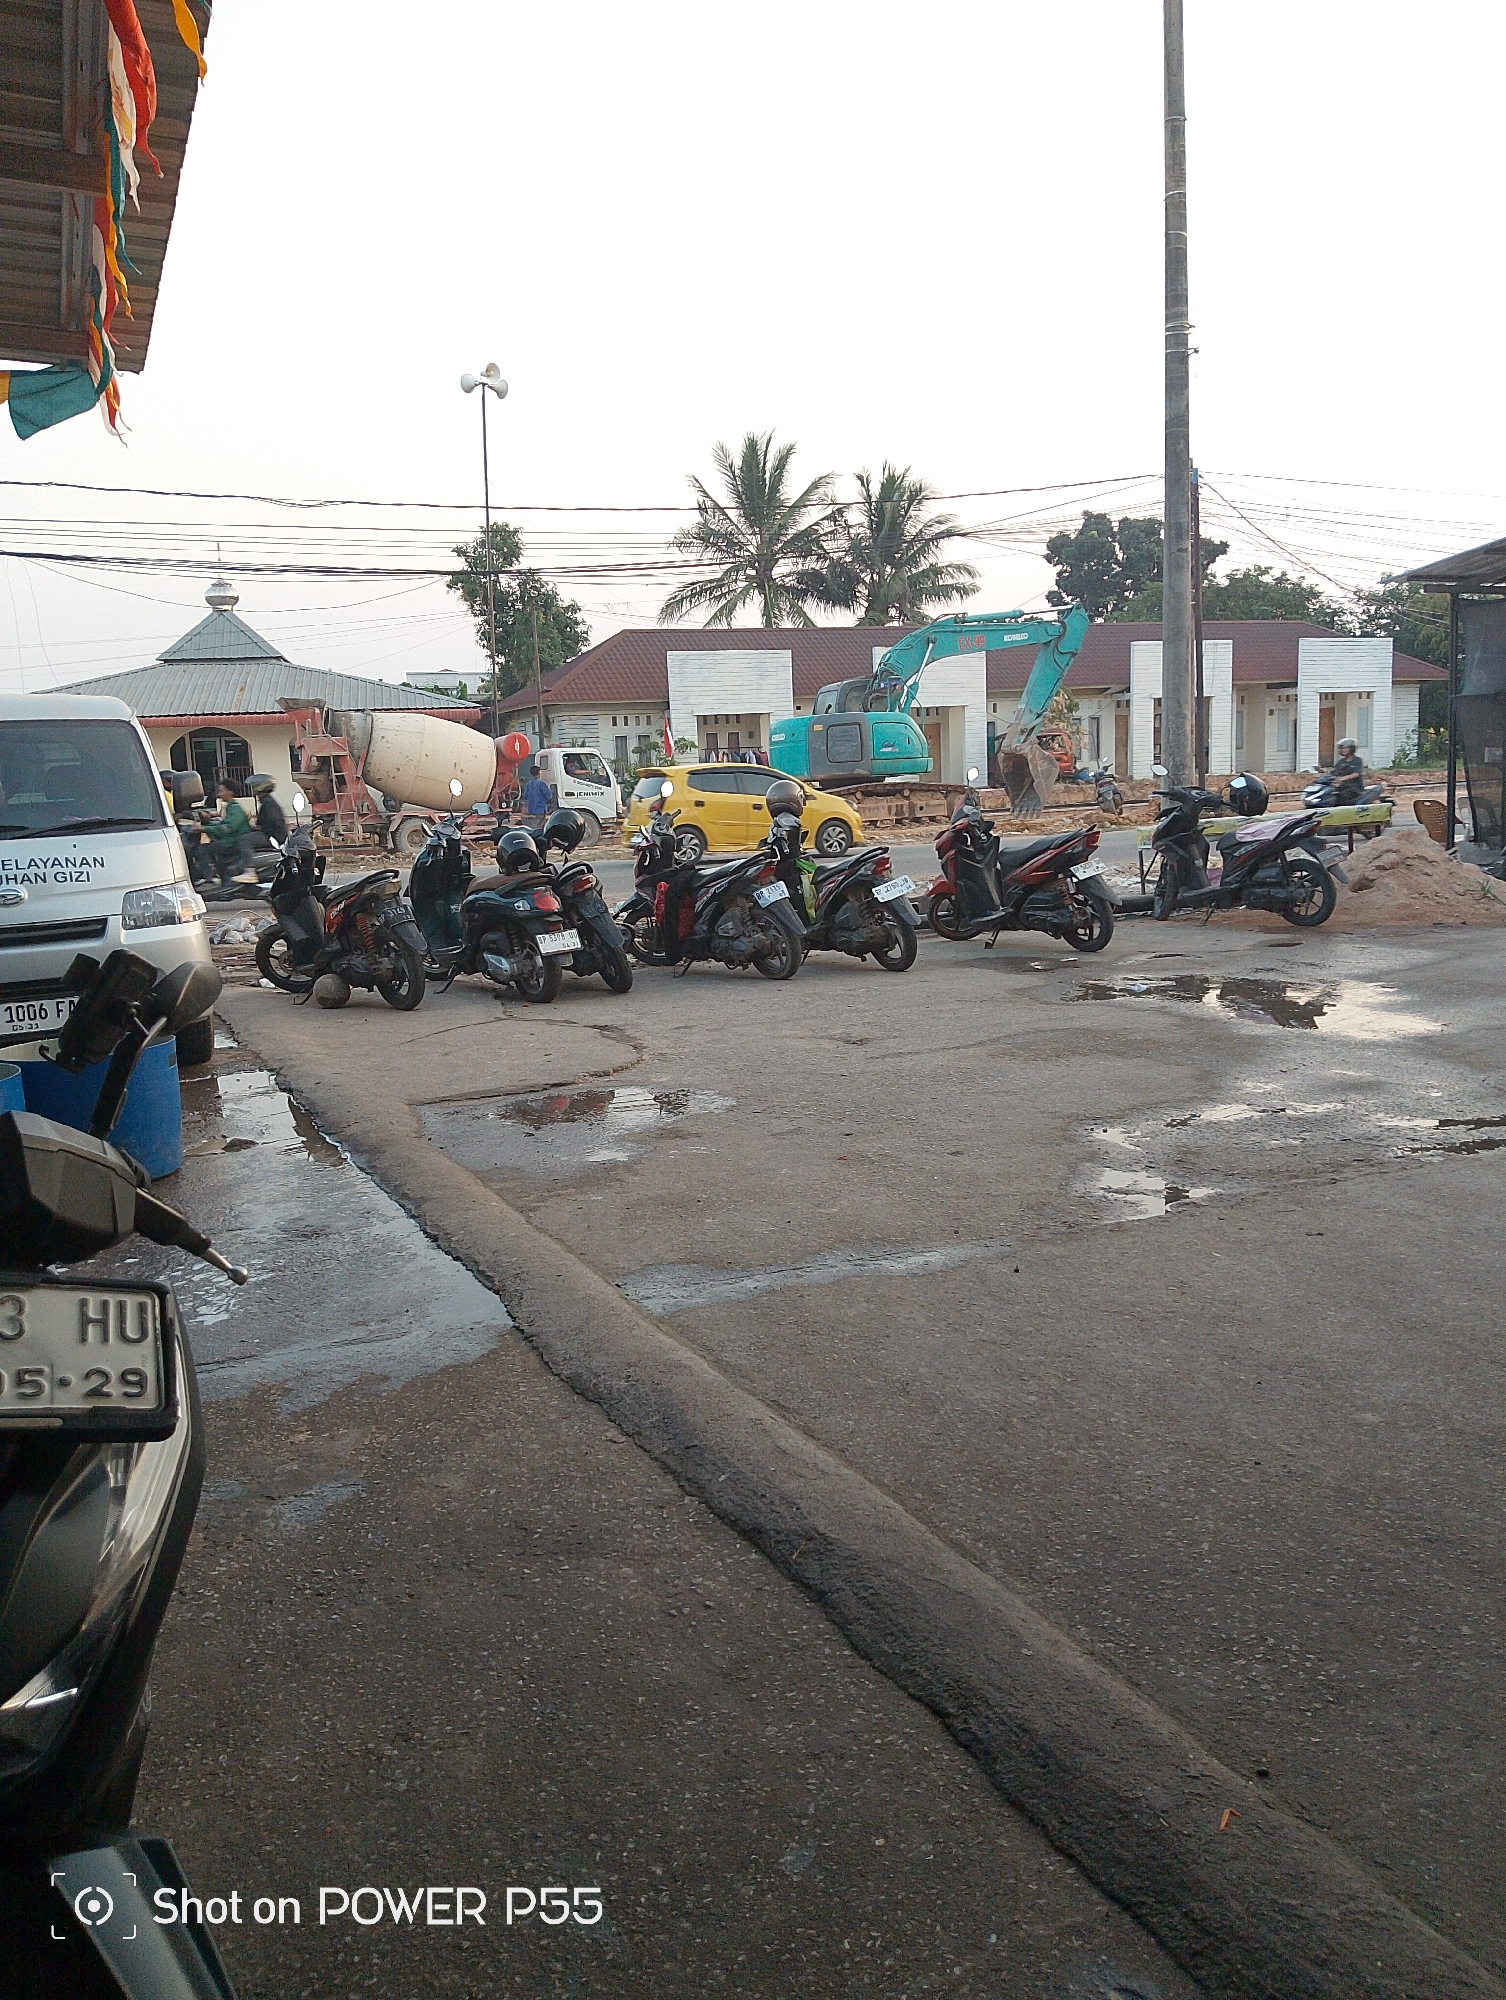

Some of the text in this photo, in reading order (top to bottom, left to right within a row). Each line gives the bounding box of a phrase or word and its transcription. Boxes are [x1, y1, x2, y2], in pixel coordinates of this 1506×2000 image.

[958, 634, 986, 650] EX-99
[0, 870, 91, 886] HAN GIZI
[4, 1002, 48, 1023] 1006
[81, 1297, 149, 1343] HU
